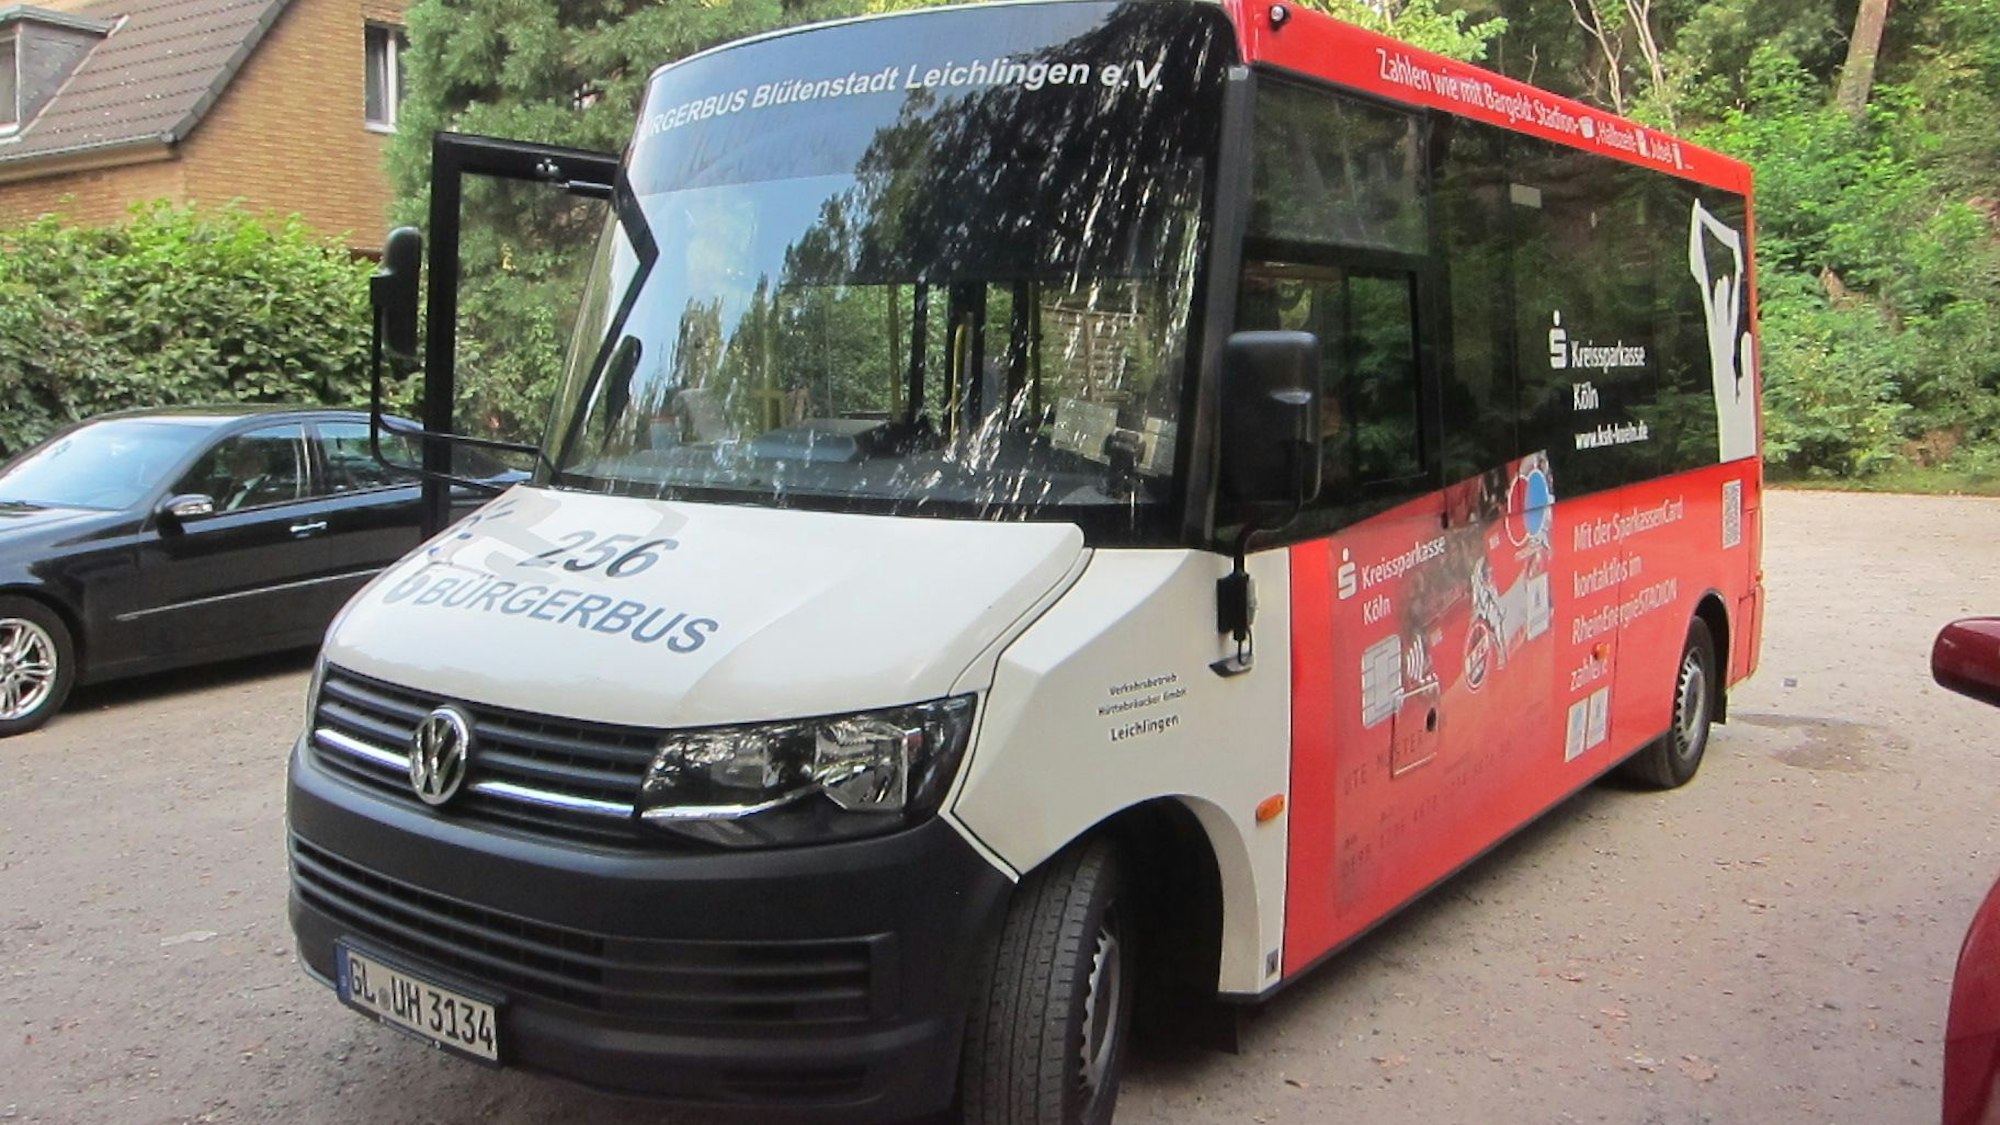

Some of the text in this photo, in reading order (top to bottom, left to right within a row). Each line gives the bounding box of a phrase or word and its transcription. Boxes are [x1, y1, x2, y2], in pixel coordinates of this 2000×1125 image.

[751, 66, 900, 109] Blütenstadt
[904, 59, 1089, 89] Leichlingen
[1101, 60, 1164, 92] e.V.
[1375, 47, 1431, 92] Zahlen
[1432, 68, 1459, 101] wie
[1460, 77, 1485, 108] mit
[1570, 339, 1646, 373] Kreissparkasse
[1572, 381, 1600, 411] Köln
[1574, 419, 1649, 450] www.ksk-koeln.de
[1573, 495, 1684, 553] Mit der SparkassenCard
[517, 530, 679, 577] 256
[1361, 535, 1446, 590] Kreissparkasse
[1573, 550, 1643, 600] kontaktlos im
[412, 574, 718, 654] BÜRGERBUS
[1362, 594, 1392, 626] Köln
[1571, 577, 1678, 646] RheinEnergieSTADION
[1110, 715, 1180, 742] Leichlingen
[350, 957, 494, 1051] GL UH 3134
